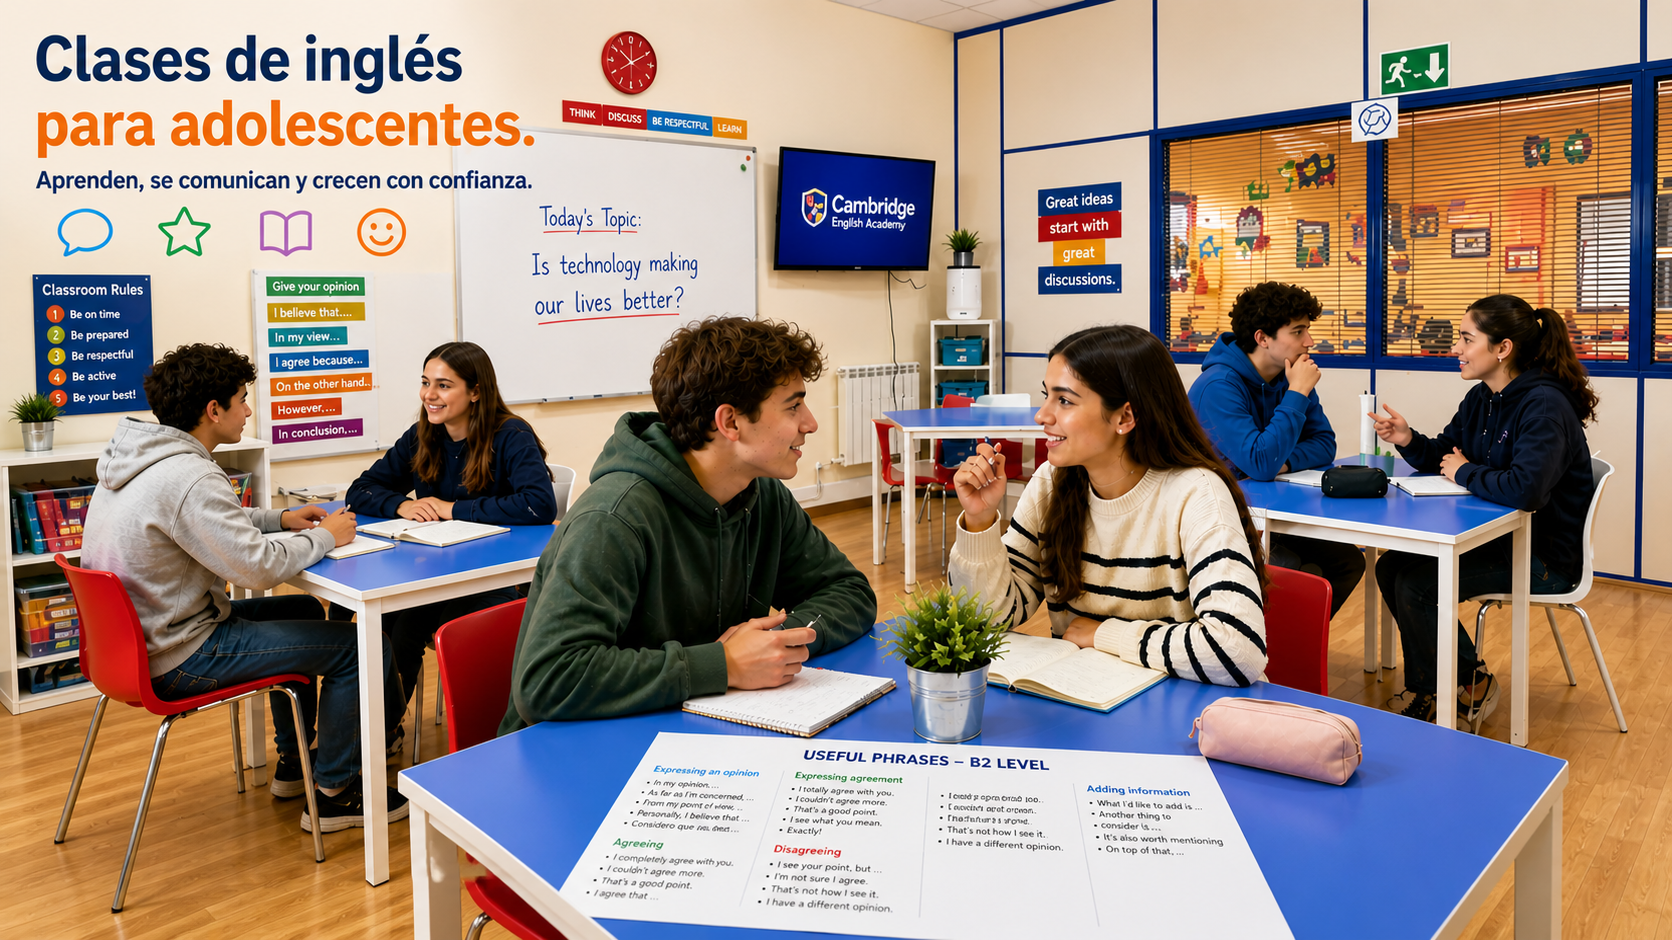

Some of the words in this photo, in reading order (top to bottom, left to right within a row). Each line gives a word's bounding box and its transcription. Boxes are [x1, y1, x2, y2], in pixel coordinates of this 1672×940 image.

[570, 108, 596, 119] THINK
[608, 112, 642, 124] DISCUSS
[652, 117, 662, 126] BE
[665, 118, 709, 130] RESPECTFUL
[718, 124, 742, 133] LEARN
[832, 194, 915, 220] Cambridge
[1046, 195, 1079, 209] Great
[1082, 192, 1113, 206] ideas
[539, 205, 593, 235] Today's
[601, 207, 641, 235] Topic:
[832, 216, 863, 230] English
[865, 218, 906, 232] Academy
[1050, 221, 1078, 234] start
[1082, 218, 1109, 232] with
[1063, 246, 1095, 263] great
[532, 253, 550, 276] Is
[560, 252, 641, 281] technology
[650, 251, 698, 280] making
[1045, 272, 1116, 286] discussions.
[42, 284, 107, 296] Classroom
[111, 283, 143, 295] Rules
[272, 281, 296, 292] Give
[298, 284, 321, 294] your
[323, 281, 360, 294] opinion
[535, 300, 564, 316] our
[576, 291, 612, 313] lives
[624, 286, 684, 310] better?
[53, 310, 57, 320] 1
[70, 310, 83, 319] Be
[99, 310, 120, 319] time
[274, 308, 277, 318] I
[280, 307, 316, 318] believe
[53, 330, 58, 340] 2
[71, 330, 84, 340] Be
[86, 329, 129, 342] prepared
[275, 332, 285, 342] In
[288, 334, 304, 345] my
[306, 331, 340, 342] view...
[54, 351, 60, 361] 3
[72, 351, 84, 361] Be
[87, 349, 134, 362] respectful
[276, 357, 279, 367] I
[282, 358, 310, 370] agree
[312, 355, 362, 365] because...
[54, 373, 59, 382] 4
[72, 372, 85, 381] Be
[88, 371, 117, 381] active
[276, 382, 291, 392] On
[294, 381, 311, 391] the
[313, 379, 339, 389] other
[73, 393, 86, 402] Be
[88, 394, 110, 404] your
[112, 390, 136, 400] best!
[279, 429, 288, 439] In
[804, 750, 866, 762] USEFUL
[872, 753, 949, 766] PHRASES
[970, 757, 992, 768] B2
[997, 758, 1050, 770] LEVEL
[653, 765, 707, 777] Expressing
[723, 769, 760, 778] opinion
[795, 772, 848, 783] Expressing
[1087, 785, 1126, 796] Adding
[1128, 787, 1190, 796] information
[787, 826, 822, 836] Exactly!
[947, 826, 974, 834] That's
[1037, 830, 1045, 838] it.
[613, 838, 664, 850] Agreeing
[952, 838, 973, 846] have
[984, 840, 1024, 849] different
[1026, 843, 1063, 852] opinion.
[1120, 834, 1138, 842] also
[1170, 837, 1224, 847] mentioning
[774, 845, 842, 858] Disagreeing
[618, 855, 667, 864] completely
[612, 866, 649, 874] couldn't
[650, 869, 677, 877] agree
[602, 877, 628, 886] That's
[639, 880, 665, 889] good
[665, 881, 692, 890] point.
[838, 878, 868, 886] agree.
[772, 885, 799, 894] That's
[821, 888, 842, 897] how
[772, 898, 796, 907] have
[807, 900, 850, 910] different
[852, 903, 893, 913] opinion.
